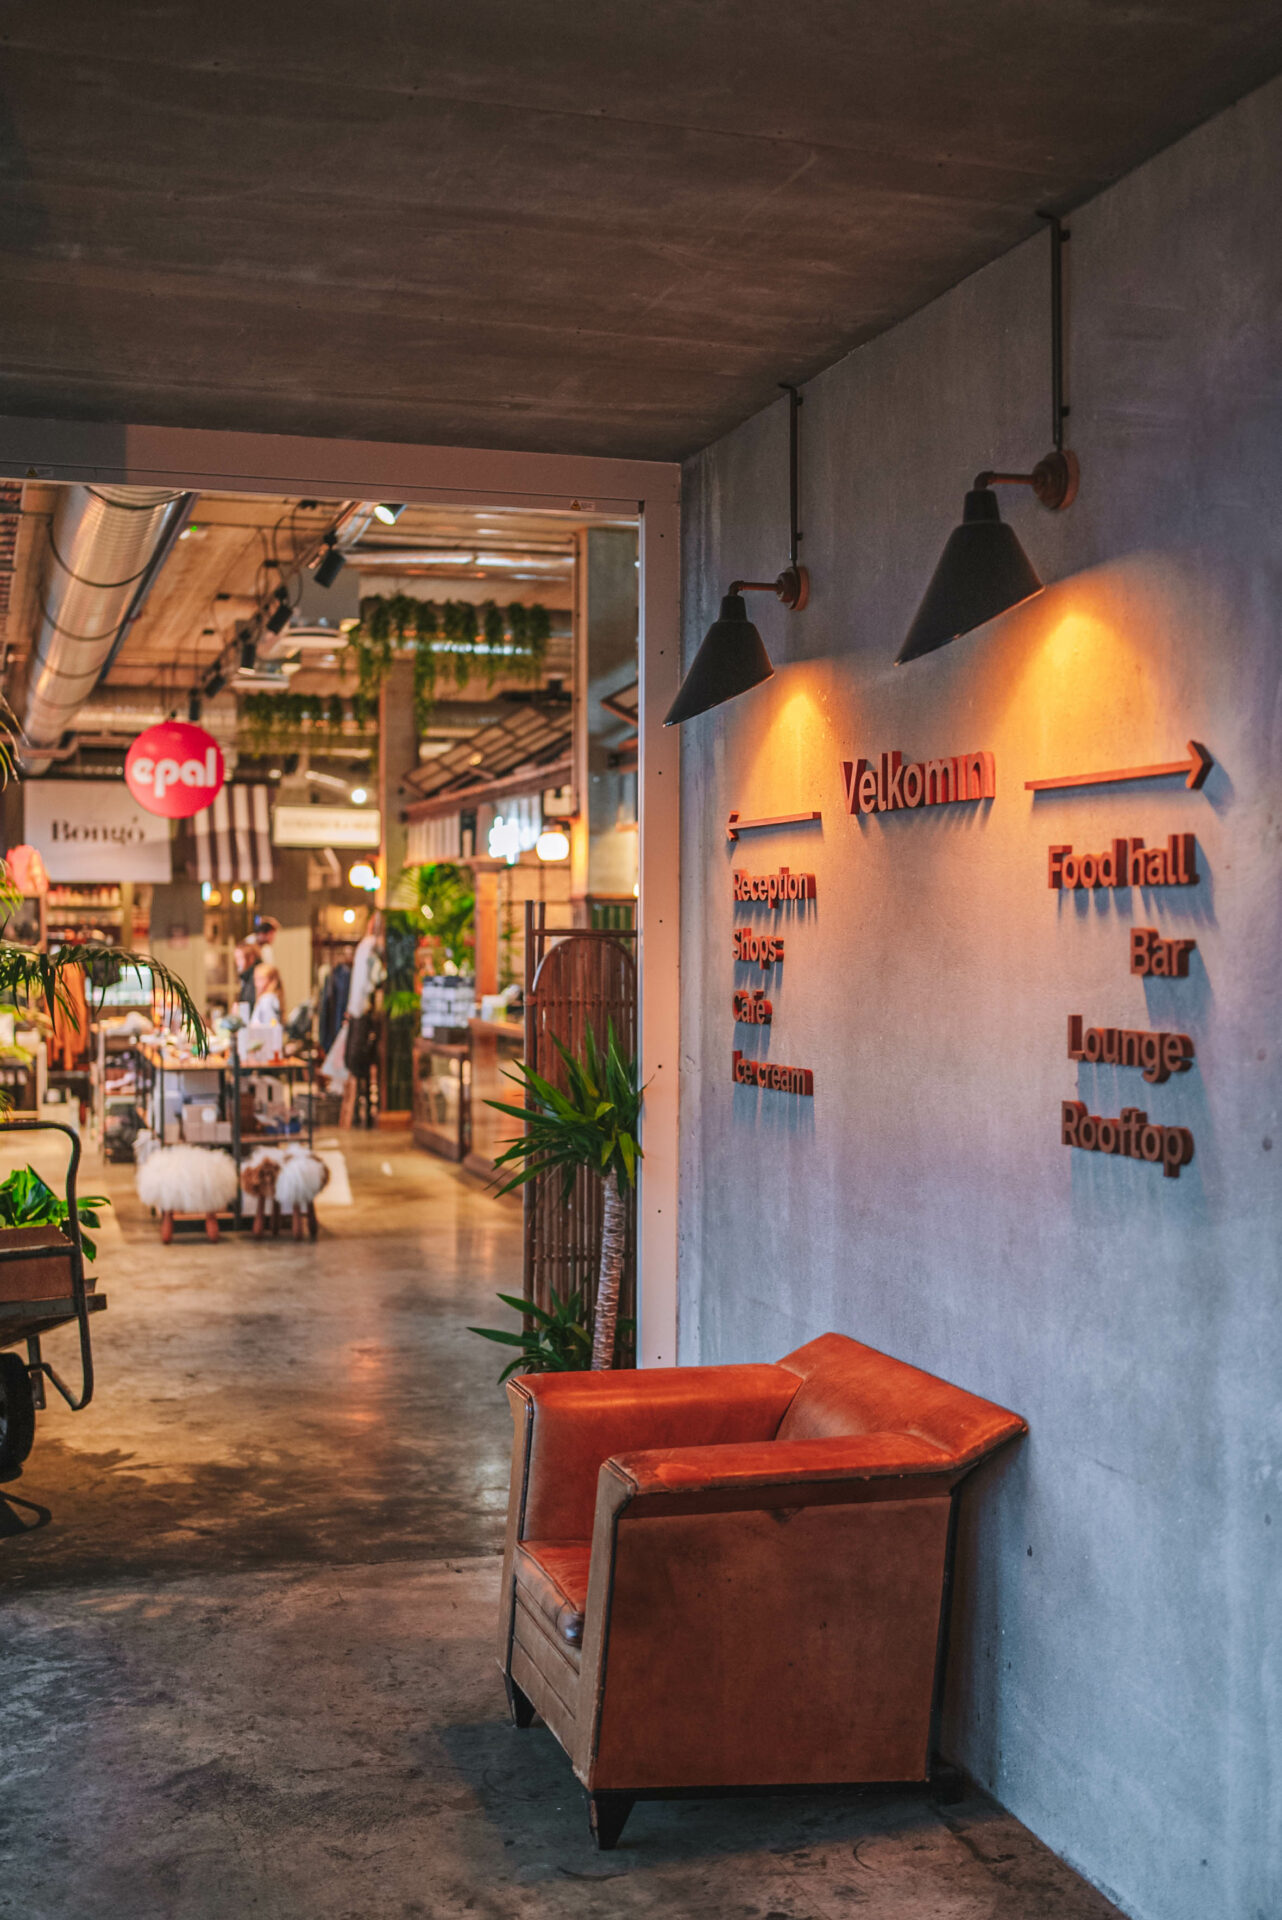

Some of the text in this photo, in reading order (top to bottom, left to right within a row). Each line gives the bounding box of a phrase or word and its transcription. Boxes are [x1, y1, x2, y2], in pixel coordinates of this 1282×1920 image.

[132, 747, 217, 798] epal
[840, 751, 996, 815] Velkomin
[1048, 833, 1201, 889] Food hall
[733, 867, 816, 909] Reception
[732, 928, 784, 970] Shops
[1130, 927, 1197, 977] Bar
[732, 1050, 814, 1096] Ice cream
[1068, 1015, 1194, 1084] Lounge
[1062, 1100, 1195, 1178] Rooftop
